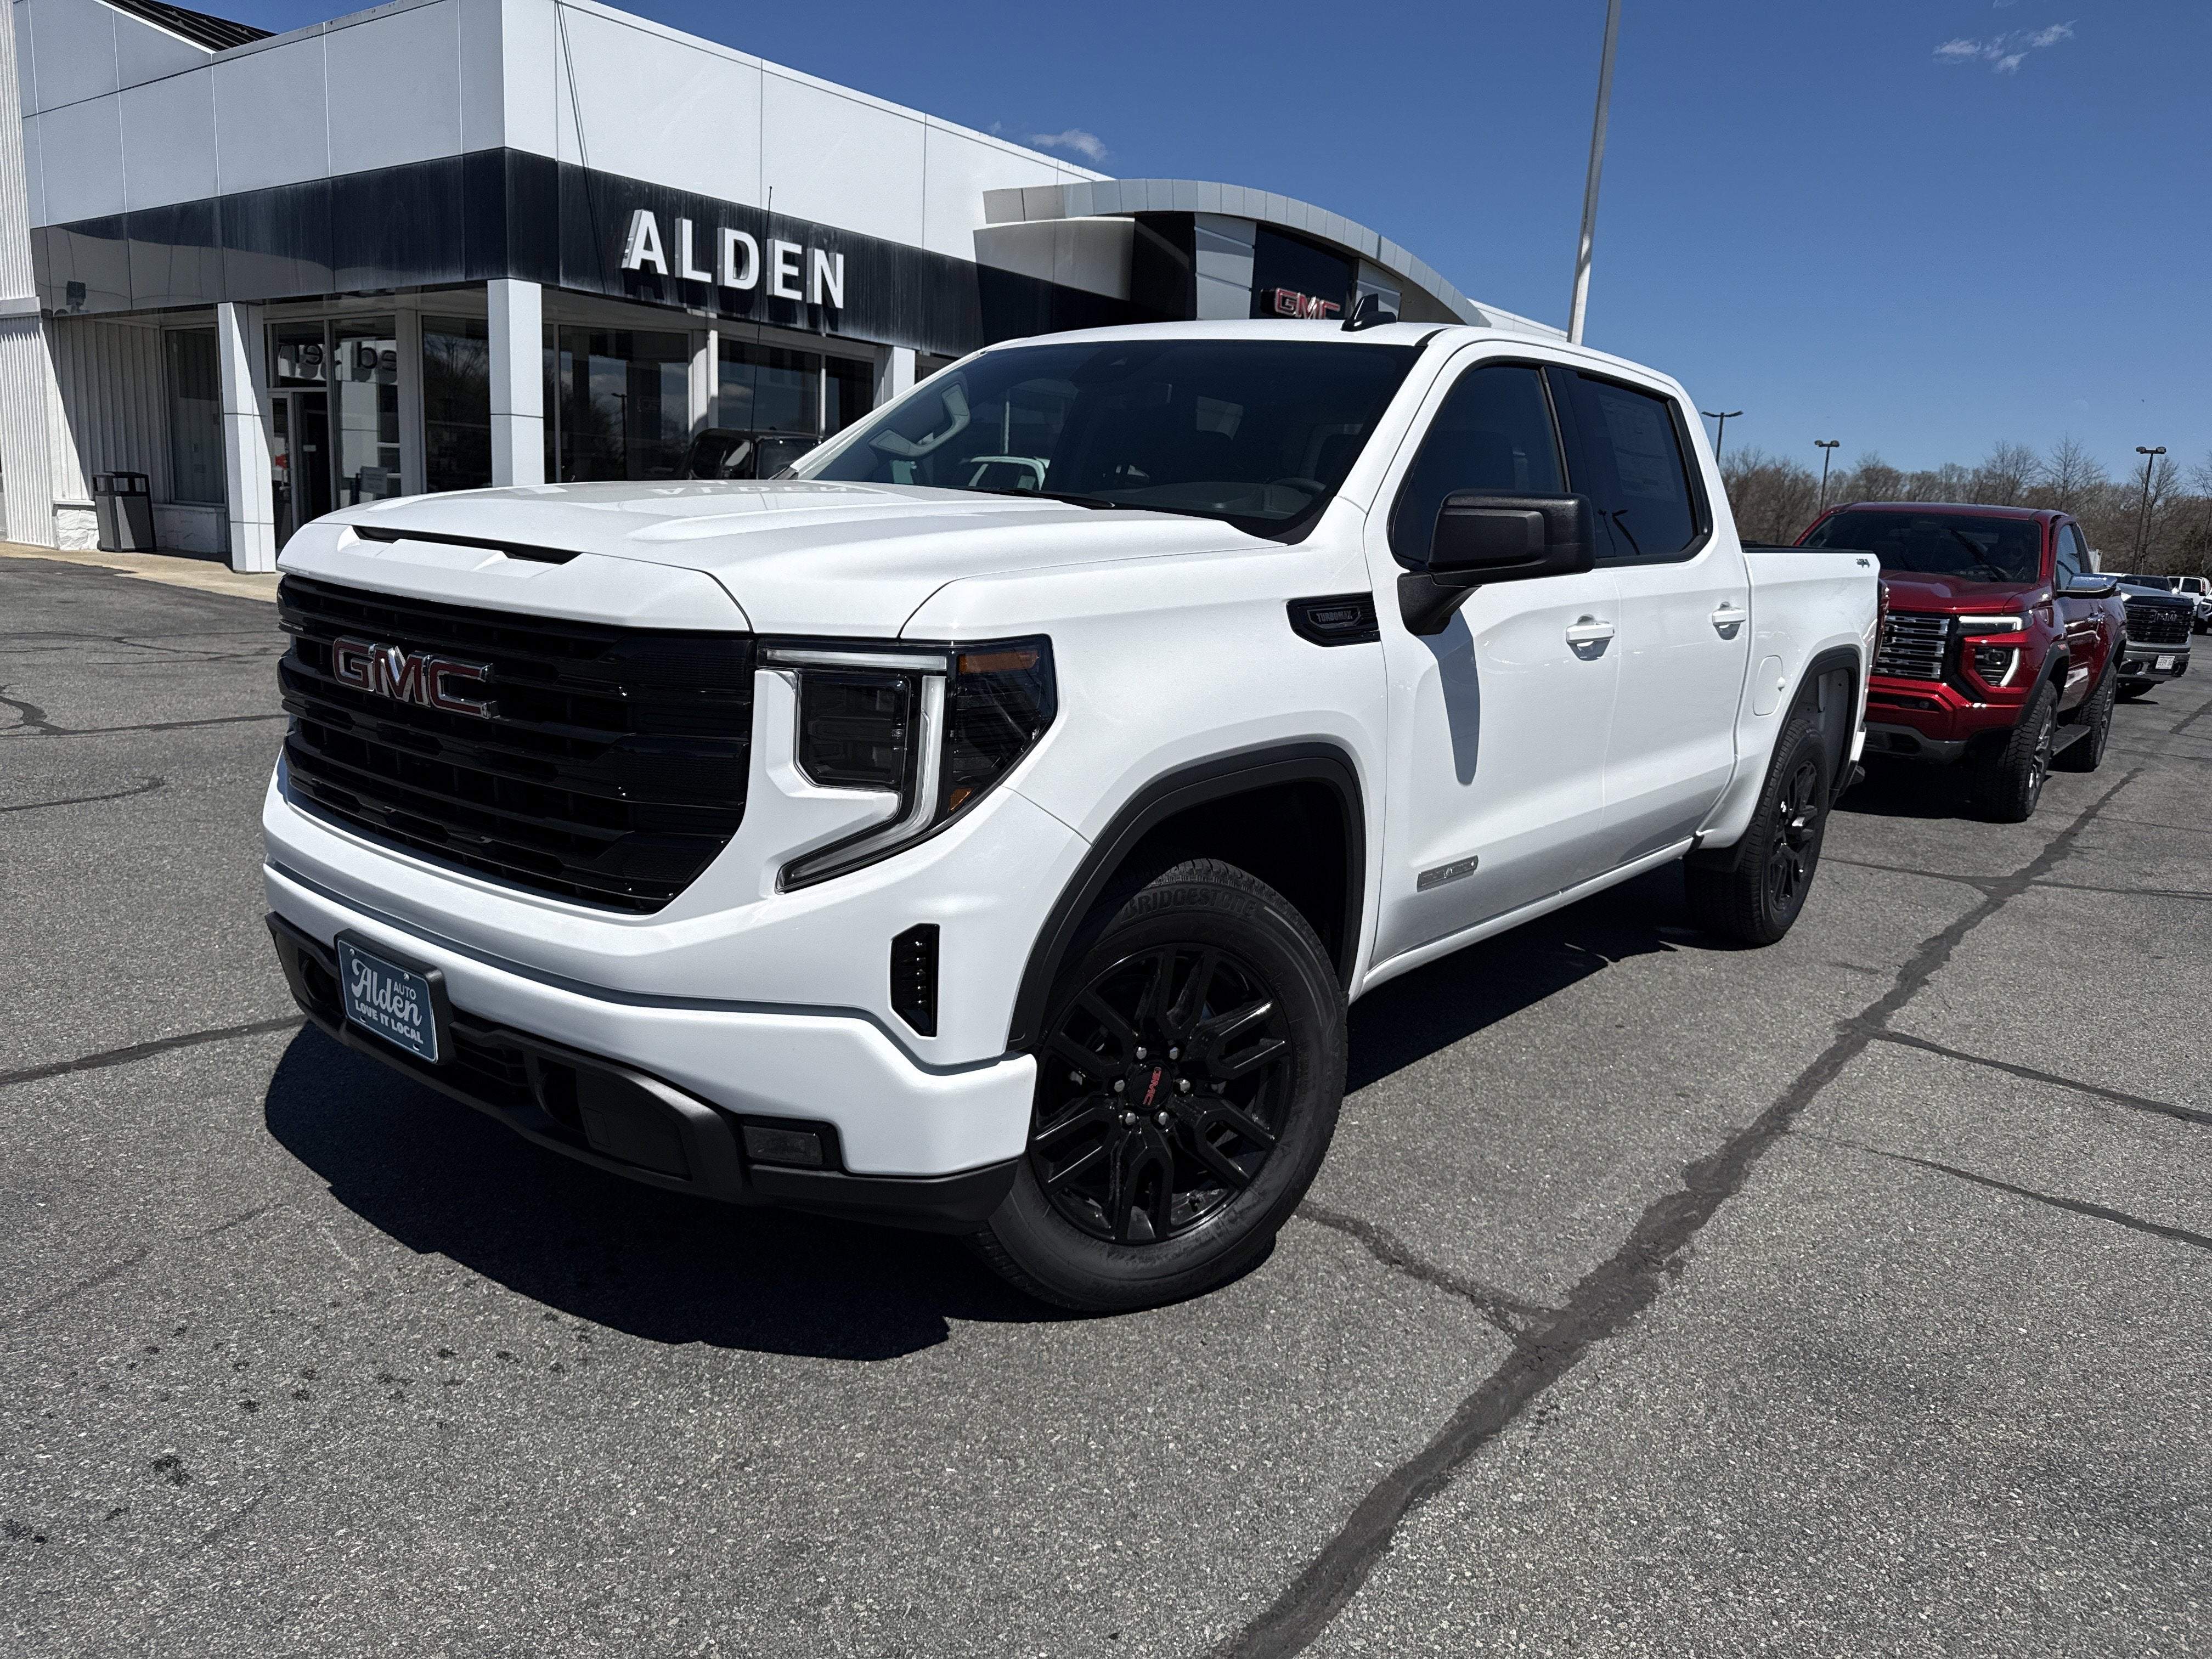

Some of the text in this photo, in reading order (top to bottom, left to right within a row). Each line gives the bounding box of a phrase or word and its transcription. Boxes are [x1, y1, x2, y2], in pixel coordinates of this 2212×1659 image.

[622, 209, 844, 309] ALDEN
[1316, 610, 1353, 622] TURBOMAX
[332, 635, 492, 719] GMC
[351, 958, 422, 1026] Alden
[393, 981, 416, 1000] AUTO
[354, 1000, 424, 1044] LOVE IT LOCAL
[1142, 1066, 1162, 1106] GMC
